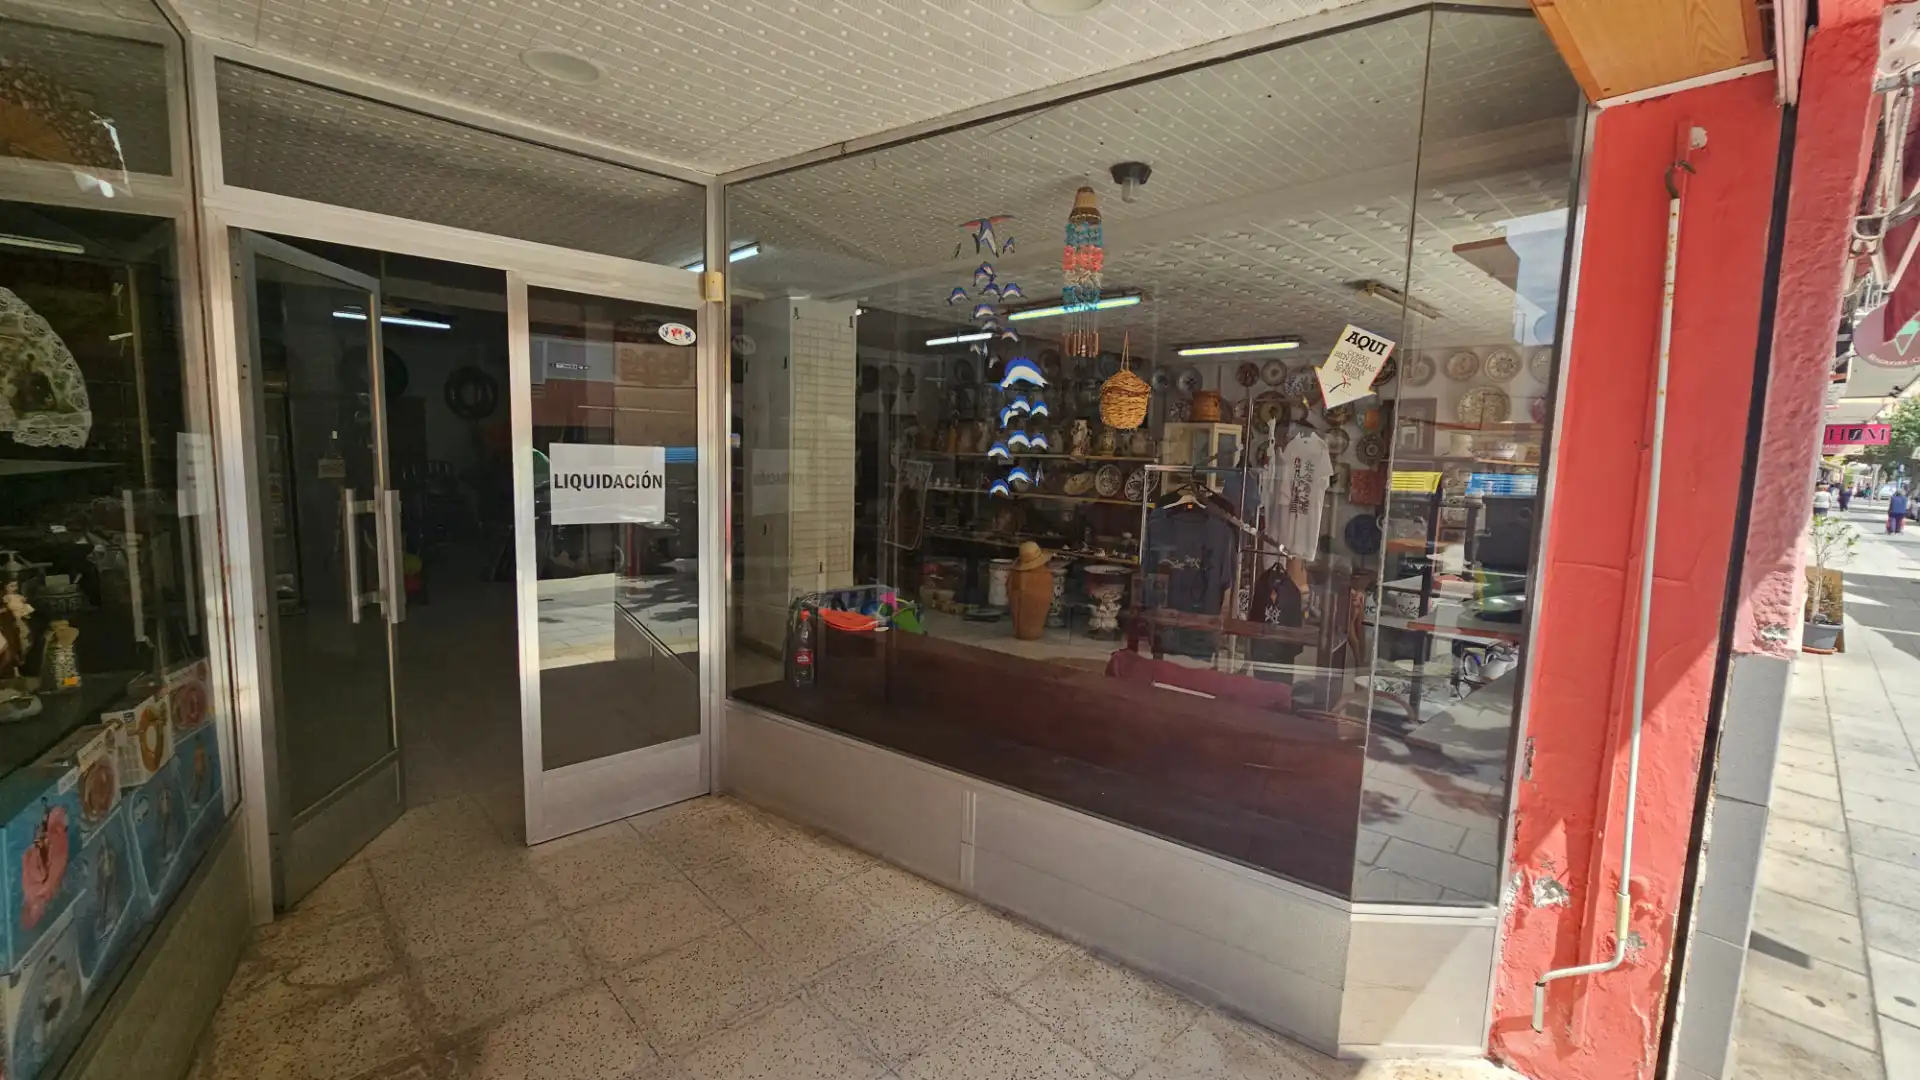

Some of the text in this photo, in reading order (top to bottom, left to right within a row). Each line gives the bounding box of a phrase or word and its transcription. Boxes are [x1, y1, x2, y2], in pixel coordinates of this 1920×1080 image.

[1345, 331, 1388, 355] AQUI
[1334, 351, 1349, 361] BIEN
[554, 470, 662, 491] LIQUIDACIÓN
